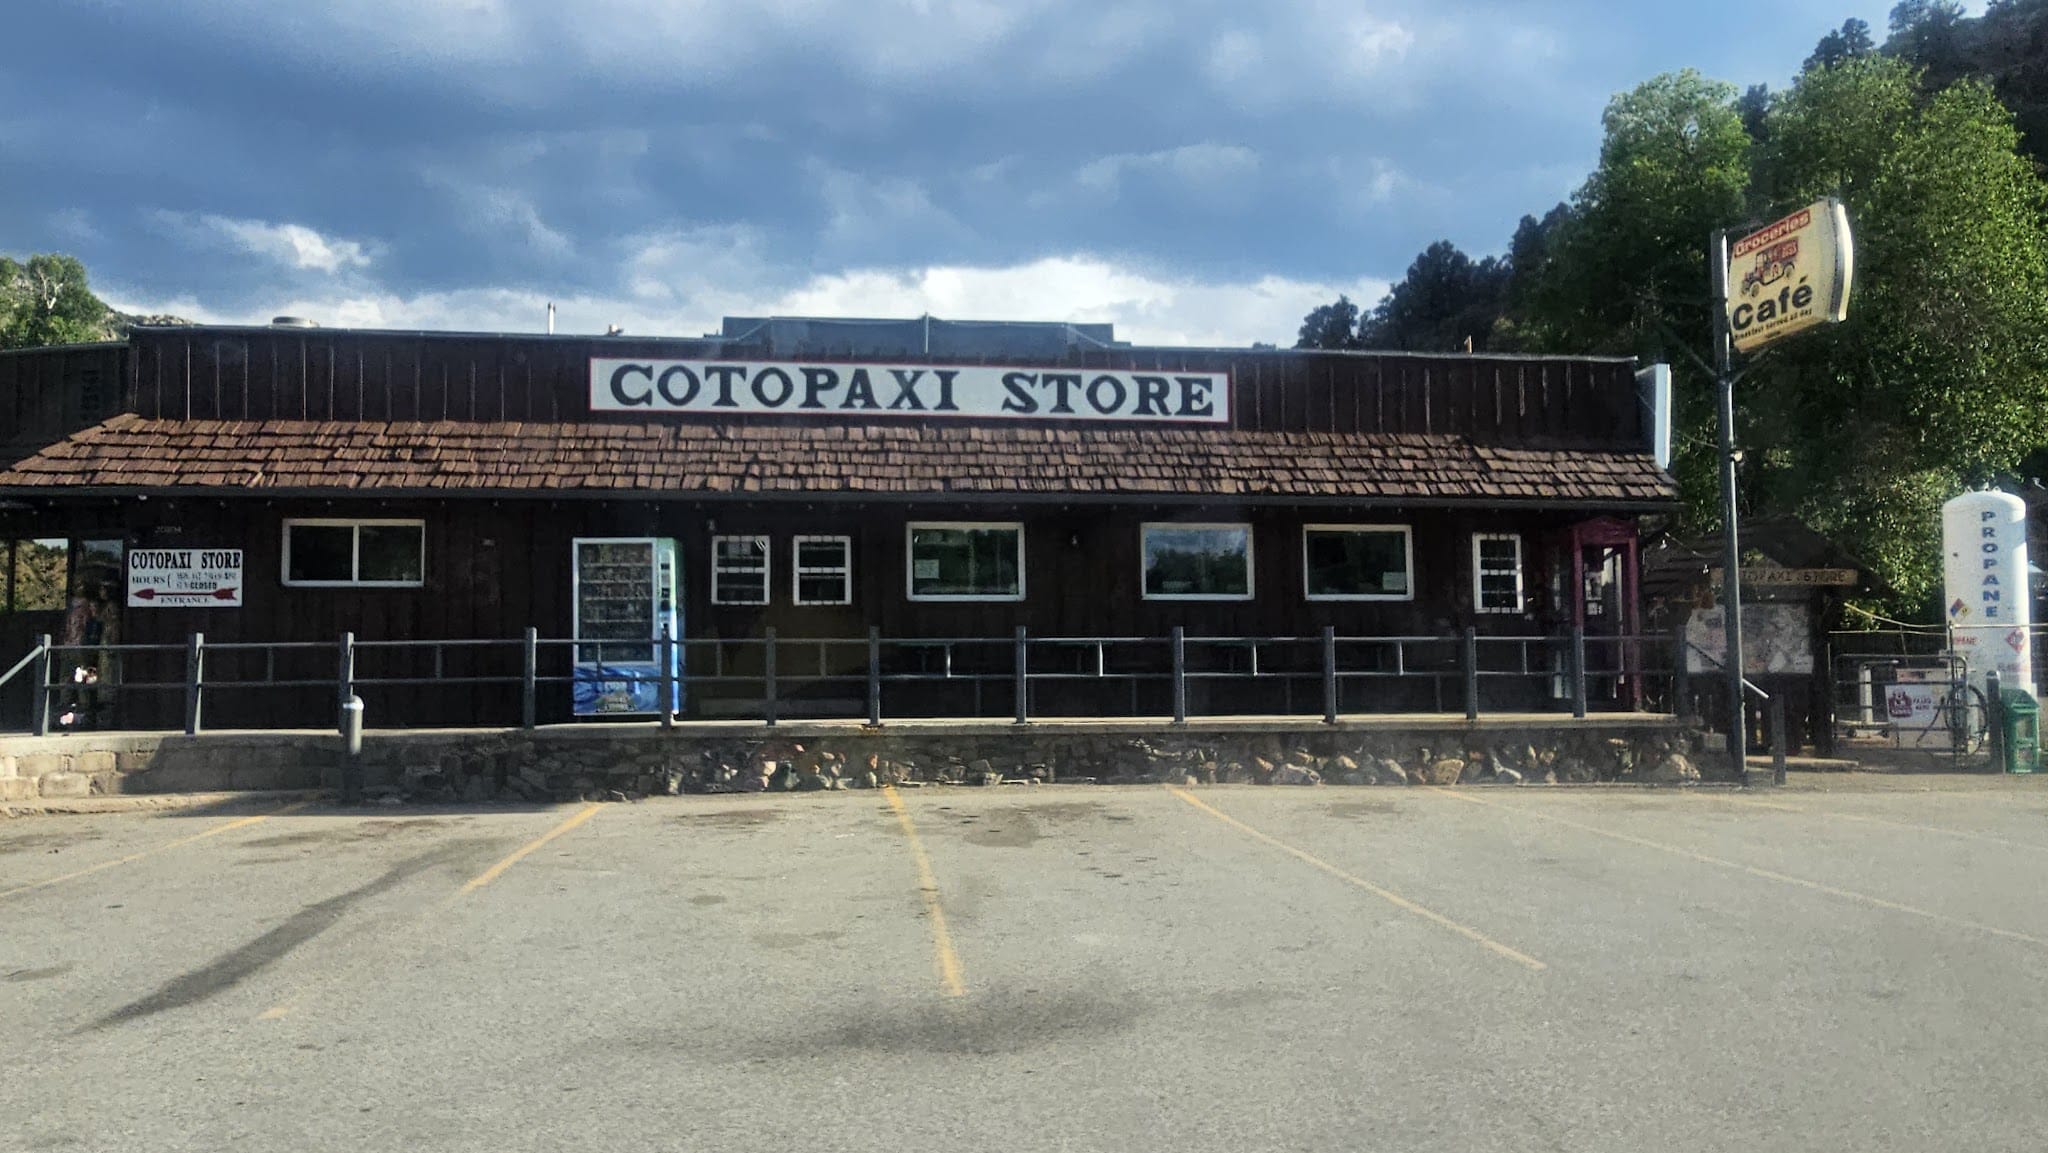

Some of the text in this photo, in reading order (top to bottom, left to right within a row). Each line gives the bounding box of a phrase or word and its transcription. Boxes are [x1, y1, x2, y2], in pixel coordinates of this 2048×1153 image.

[1736, 212, 1809, 257] Groceries
[1732, 275, 1813, 331] Café
[610, 363, 1214, 416] COTOPAXI STORE
[131, 552, 241, 569] COTOPAXI STORE
[132, 575, 165, 585] HOURS
[1981, 511, 2000, 617] PROPANE
[160, 597, 209, 605] ENTRANCE
